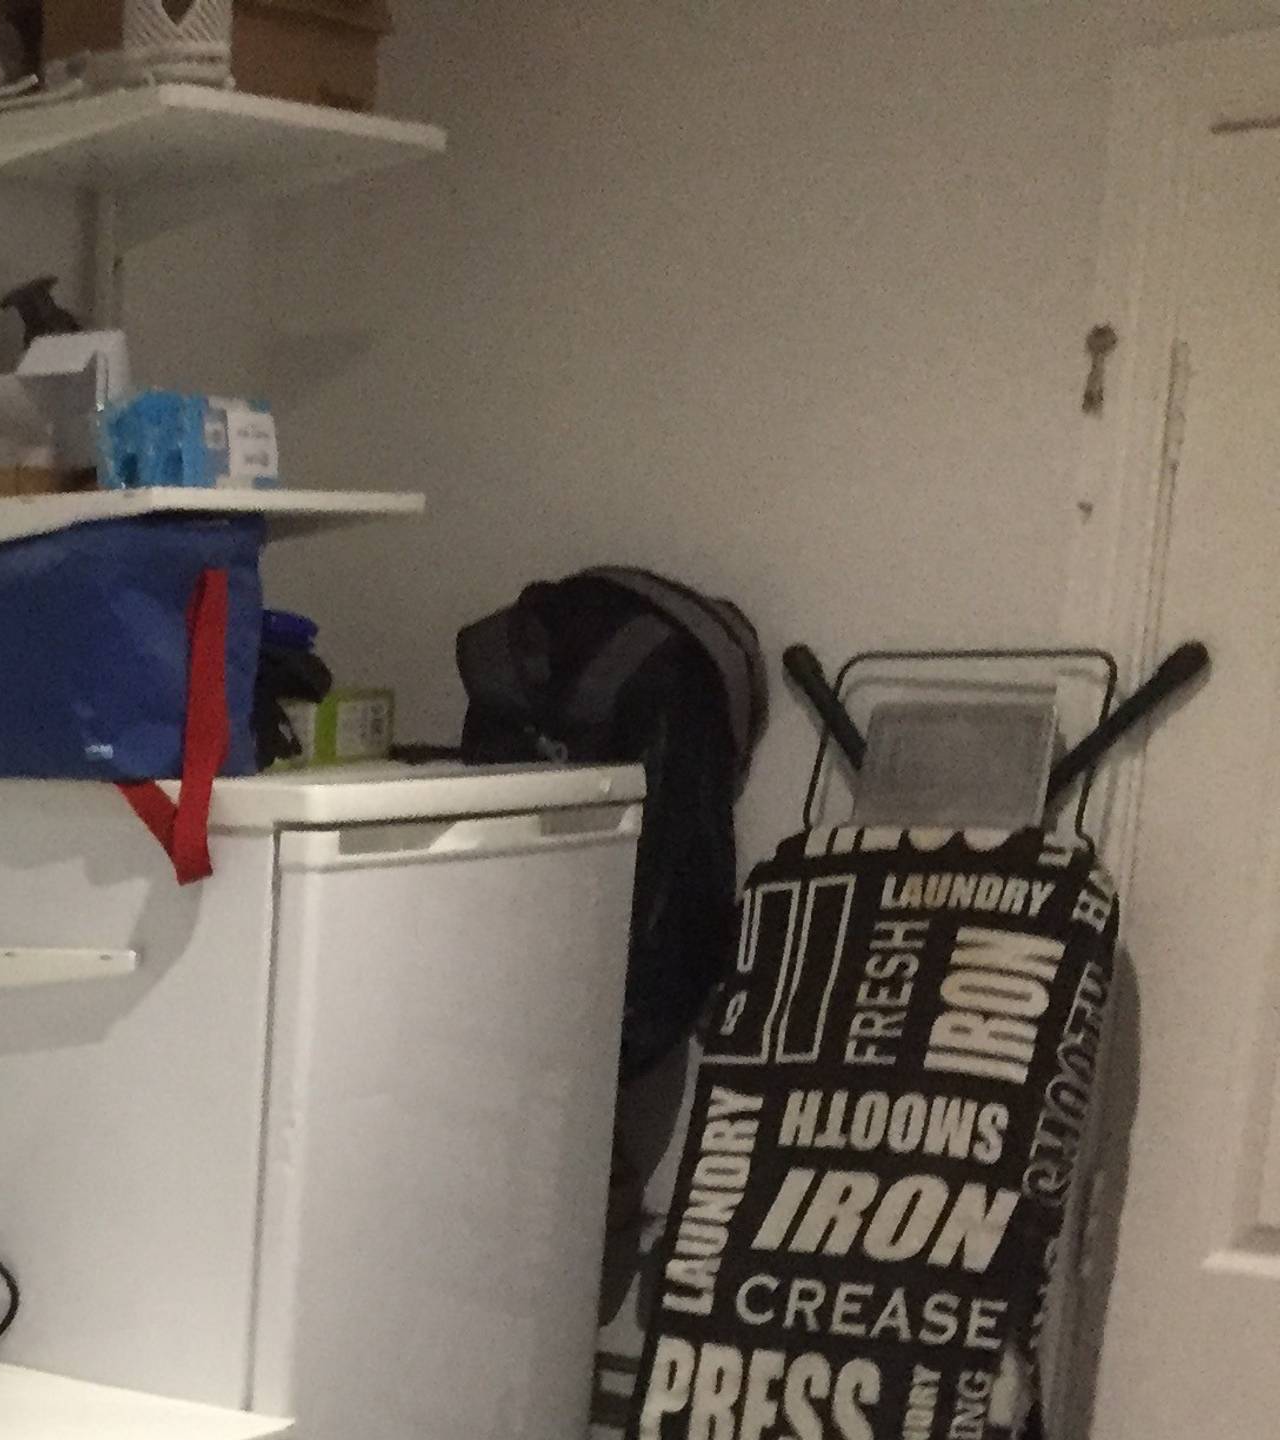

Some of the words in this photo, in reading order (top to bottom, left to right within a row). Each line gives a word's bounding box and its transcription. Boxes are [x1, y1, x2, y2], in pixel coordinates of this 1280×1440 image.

[880, 872, 1057, 918] LAUNDRY
[844, 919, 930, 1065] FRESH
[923, 925, 1066, 1085] IRON
[778, 1089, 1008, 1166] SMOOTH
[662, 1085, 764, 1317] LAUNDRY
[751, 1167, 1022, 1273] IRON
[735, 1273, 1008, 1350] CREASE
